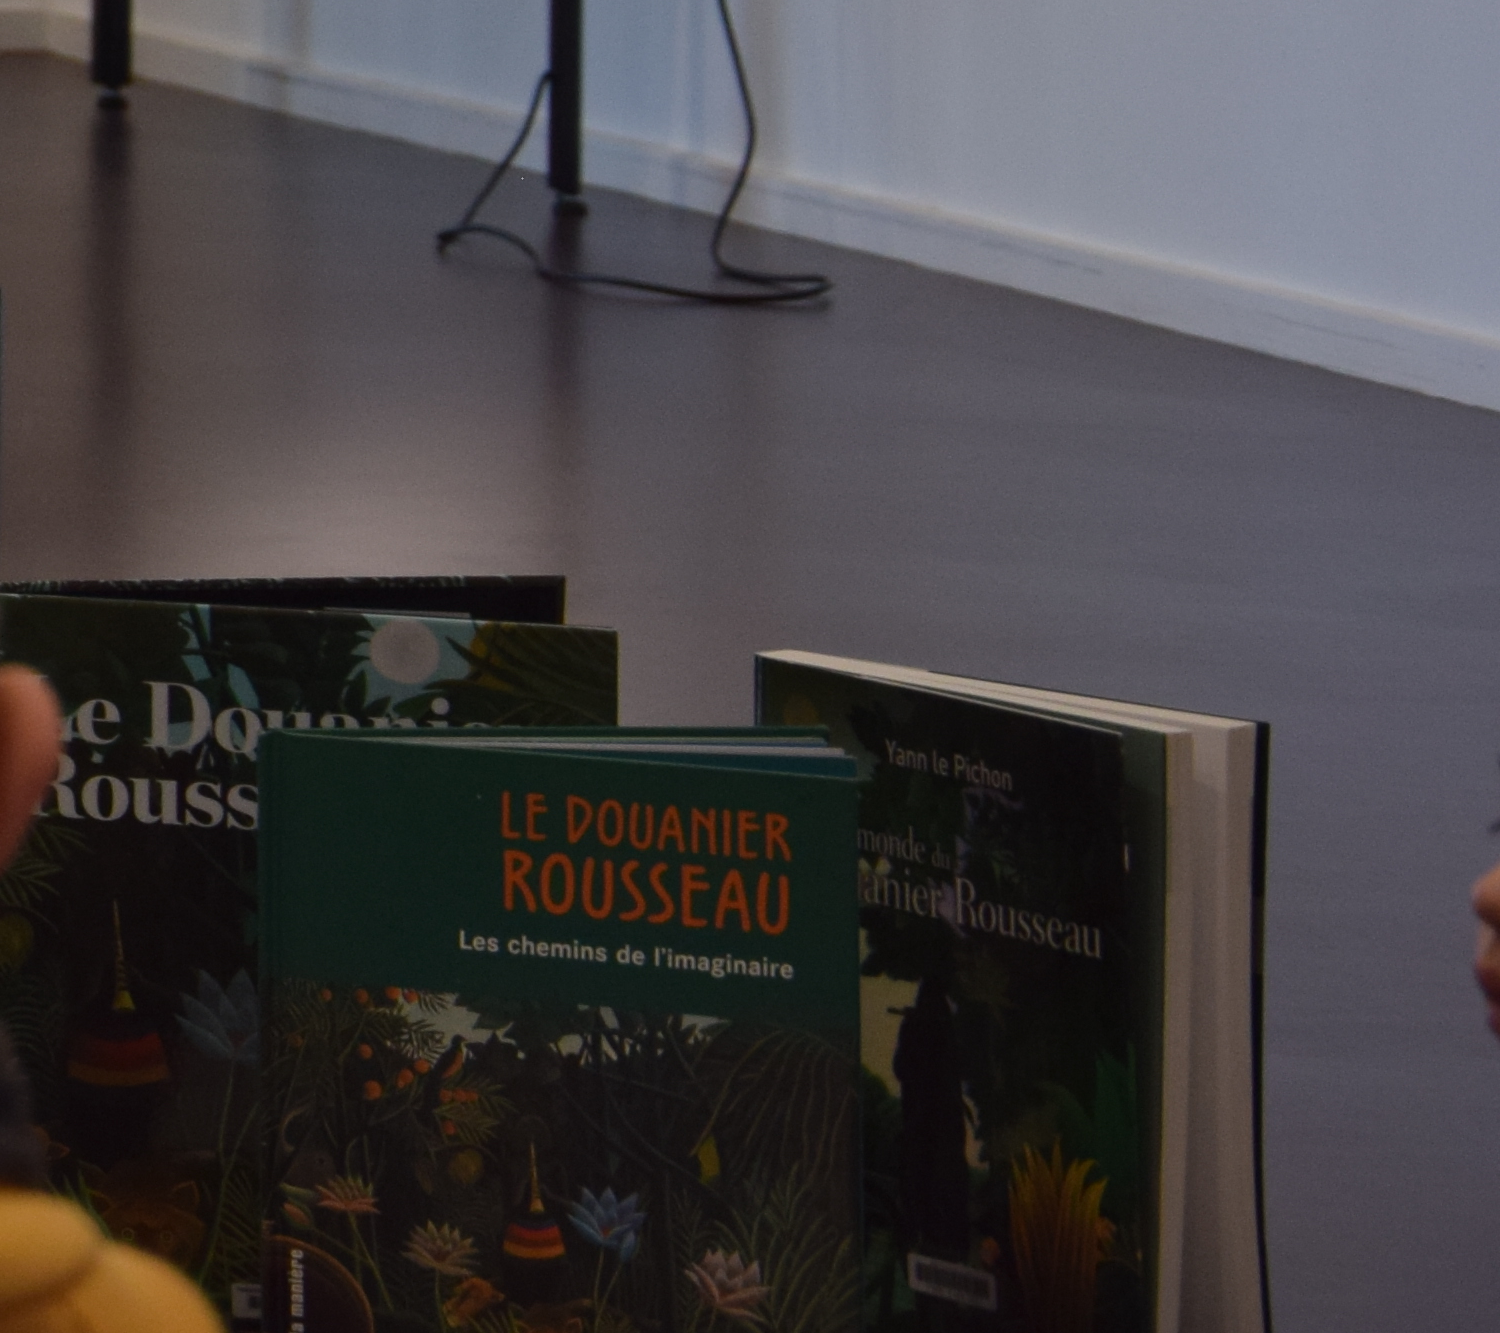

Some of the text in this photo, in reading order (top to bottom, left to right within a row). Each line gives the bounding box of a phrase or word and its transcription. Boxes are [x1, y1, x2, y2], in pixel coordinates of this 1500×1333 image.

[33, 754, 258, 831] Rouss
[884, 737, 1013, 792] Yann le Pichon
[502, 790, 792, 862] LE DOUANIER
[858, 826, 950, 870] monde du
[502, 848, 791, 936] ROUSSEAU
[859, 867, 1102, 959] anier Rousseau
[458, 929, 795, 980] Les chemins de l'imaginaire
[288, 1248, 305, 1318] manière
